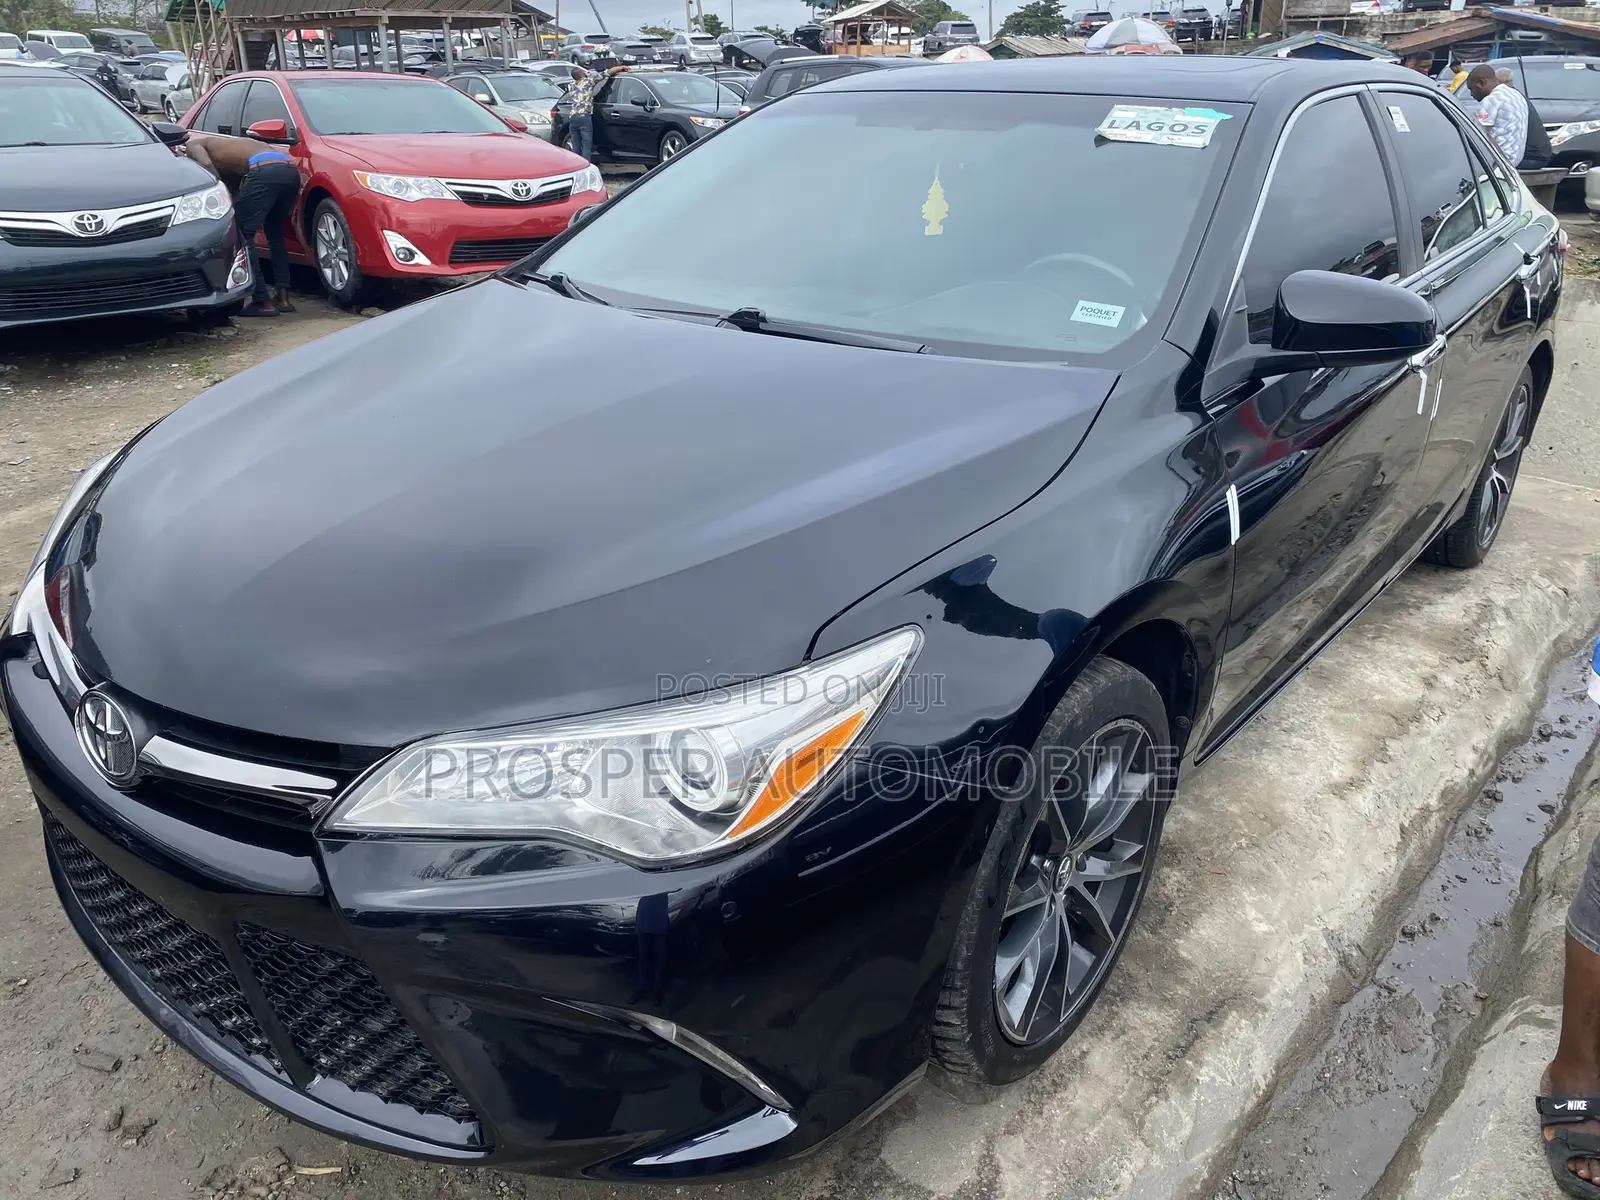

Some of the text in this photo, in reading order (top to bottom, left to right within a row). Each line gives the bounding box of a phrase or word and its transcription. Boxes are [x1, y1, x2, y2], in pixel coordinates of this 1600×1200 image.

[1106, 119, 1208, 135] LAGOS
[1080, 306, 1118, 317] POQUET
[1567, 1100, 1588, 1111] NIKE
